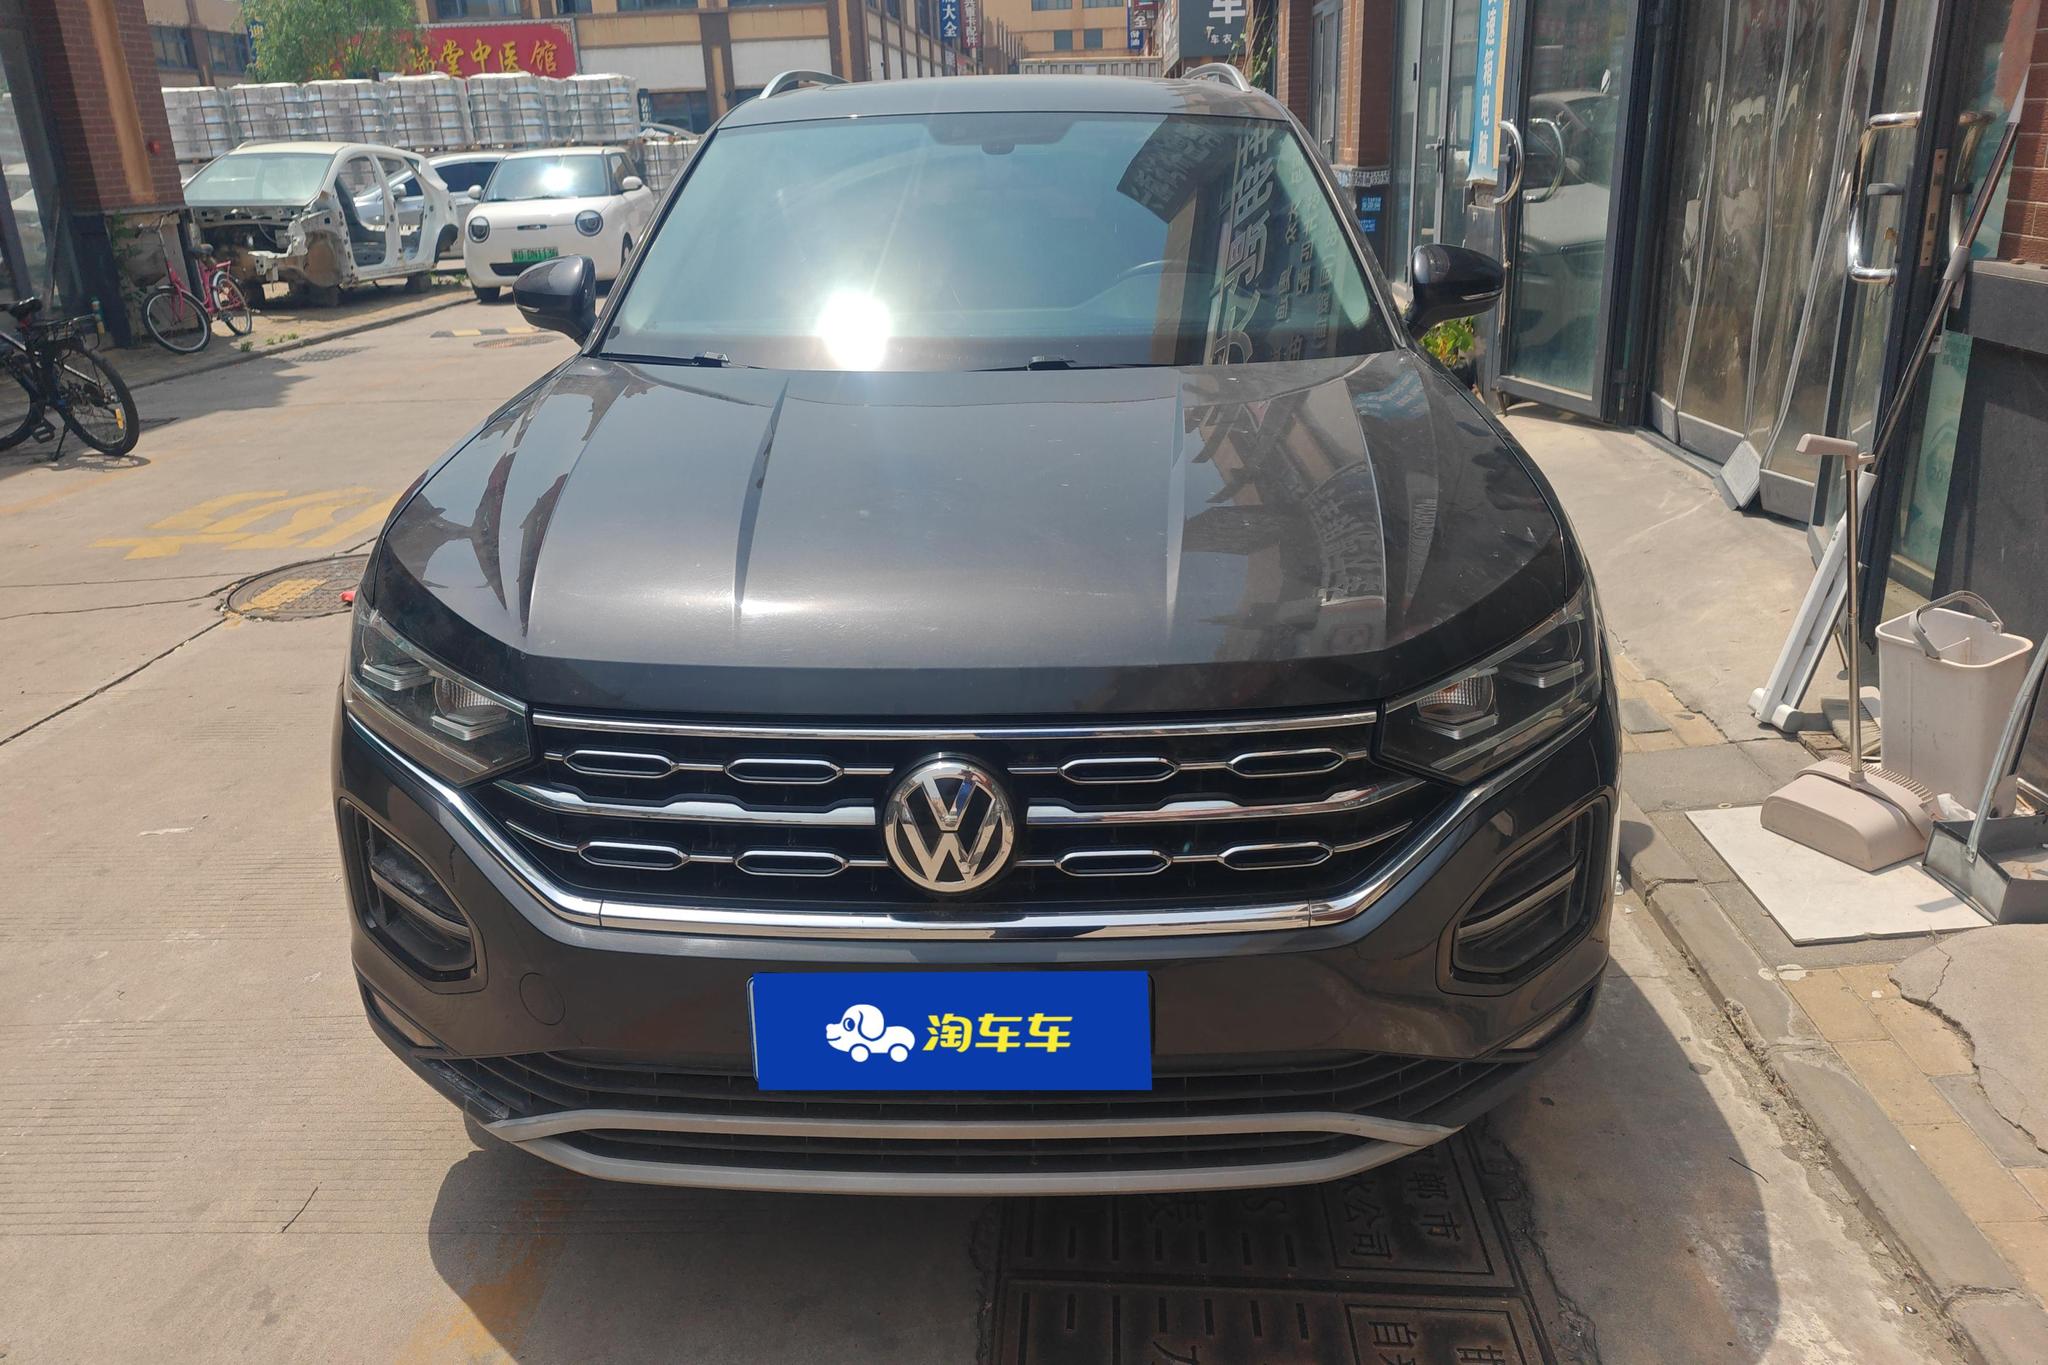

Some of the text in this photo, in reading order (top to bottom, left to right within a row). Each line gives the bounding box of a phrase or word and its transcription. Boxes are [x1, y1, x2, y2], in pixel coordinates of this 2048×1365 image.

[943, 0, 959, 37] 大全
[1477, 0, 1497, 165] 速箱电脑
